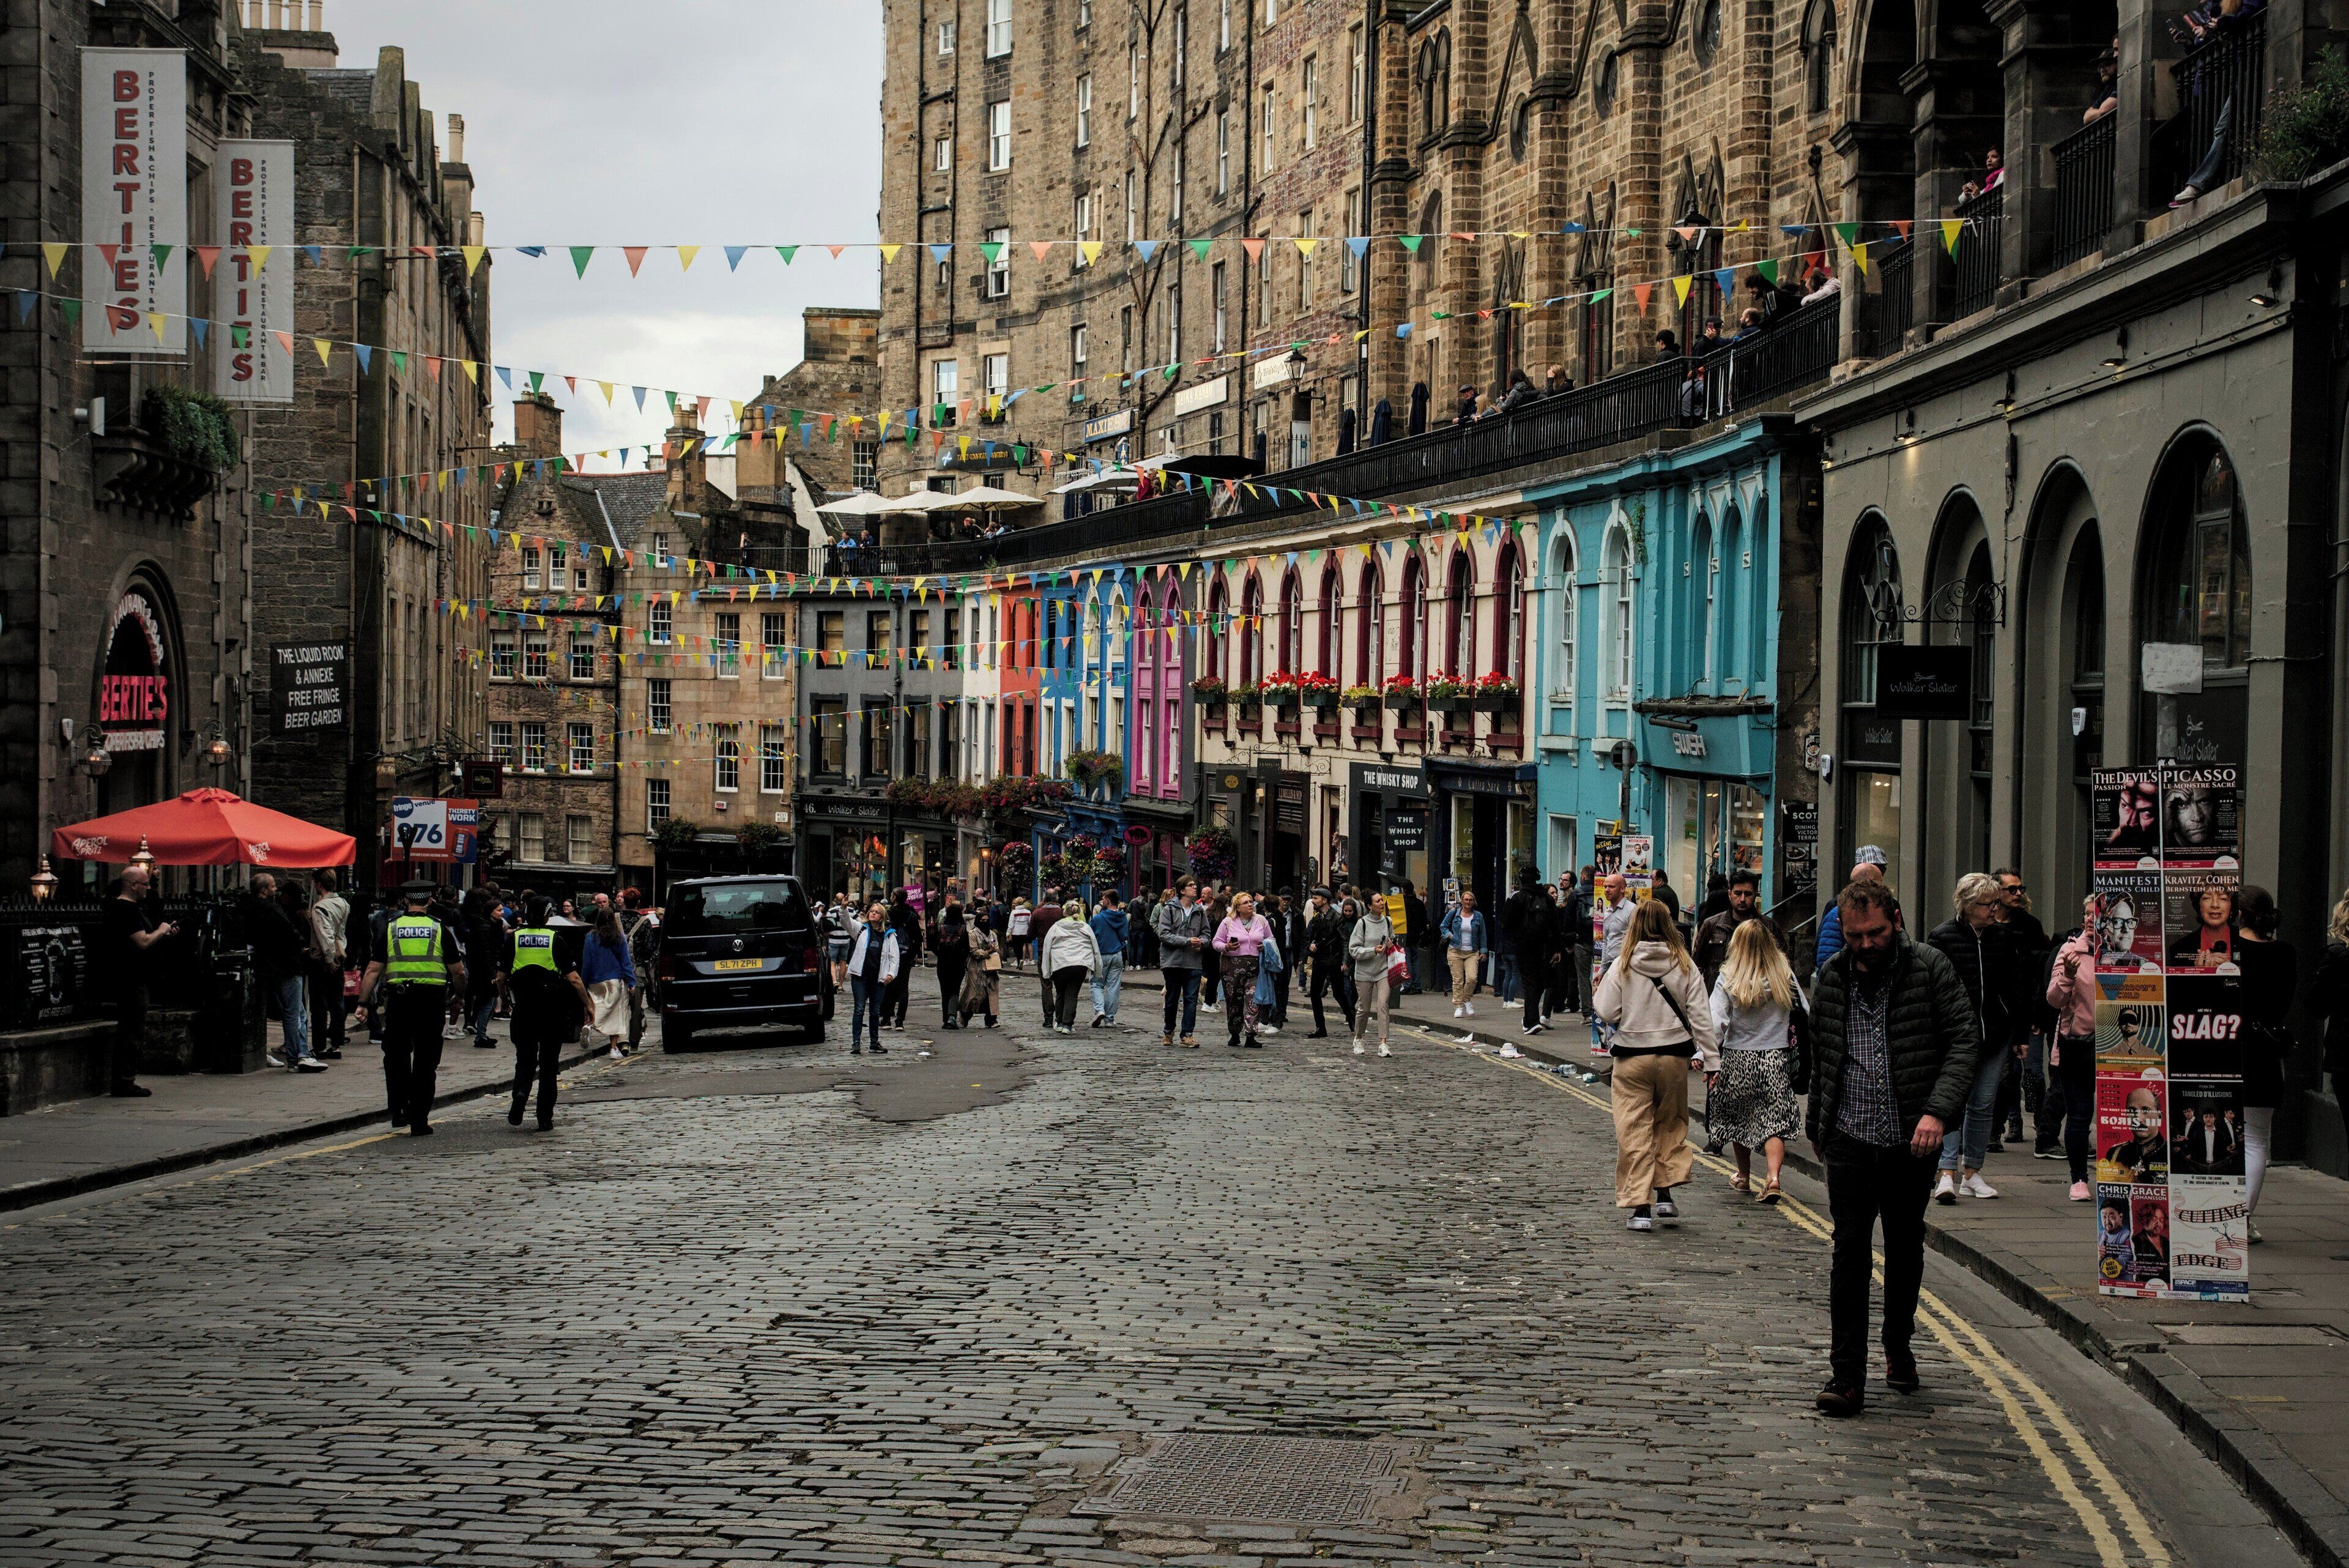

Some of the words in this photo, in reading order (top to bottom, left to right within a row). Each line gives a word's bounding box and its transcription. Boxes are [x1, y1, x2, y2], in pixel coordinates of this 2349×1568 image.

[113, 70, 141, 330] BERTIES
[231, 158, 254, 382] BERTIES
[277, 648, 295, 664] THE
[294, 647, 321, 663] LIQUID
[322, 645, 344, 661] ROOM
[295, 669, 302, 685] &
[303, 667, 334, 684] ANNEXE
[1890, 682, 1926, 693] Walker
[1928, 682, 1958, 693] Slater
[100, 675, 168, 721] BERTIE'S
[288, 690, 311, 707] FREE
[313, 688, 340, 704] FRINGE
[284, 712, 310, 729] BEER
[311, 708, 342, 726] GARDEN
[2176, 737, 2195, 760] alker
[2197, 738, 2219, 761] Slater
[1364, 771, 1376, 784] THE
[1376, 771, 1400, 787] WHISKY
[1401, 774, 1418, 789] SHOP
[2093, 773, 2115, 784] THE
[2164, 769, 2236, 782] PICASSO
[393, 802, 412, 812] fringe
[828, 804, 854, 815] Walker
[858, 804, 880, 816] Slater
[72, 836, 108, 850] APEROL
[248, 841, 270, 856] APEROL
[1595, 841, 1612, 849] INSANE
[2095, 876, 2159, 885] MANIFEST
[2165, 875, 2203, 885] KRAVITZ,
[2206, 875, 2239, 885] COHEN
[398, 928, 429, 937] POLICE
[519, 937, 549, 946] POLICE
[2102, 983, 2157, 992] TOMORROW'S
[2171, 1013, 2242, 1040] SLAG?
[2098, 1185, 2129, 1194] CHRIS
[2132, 1187, 2167, 1197] GRACE
[2178, 1204, 2249, 1223] CUTTING
[2177, 1254, 2228, 1270] EDGE
